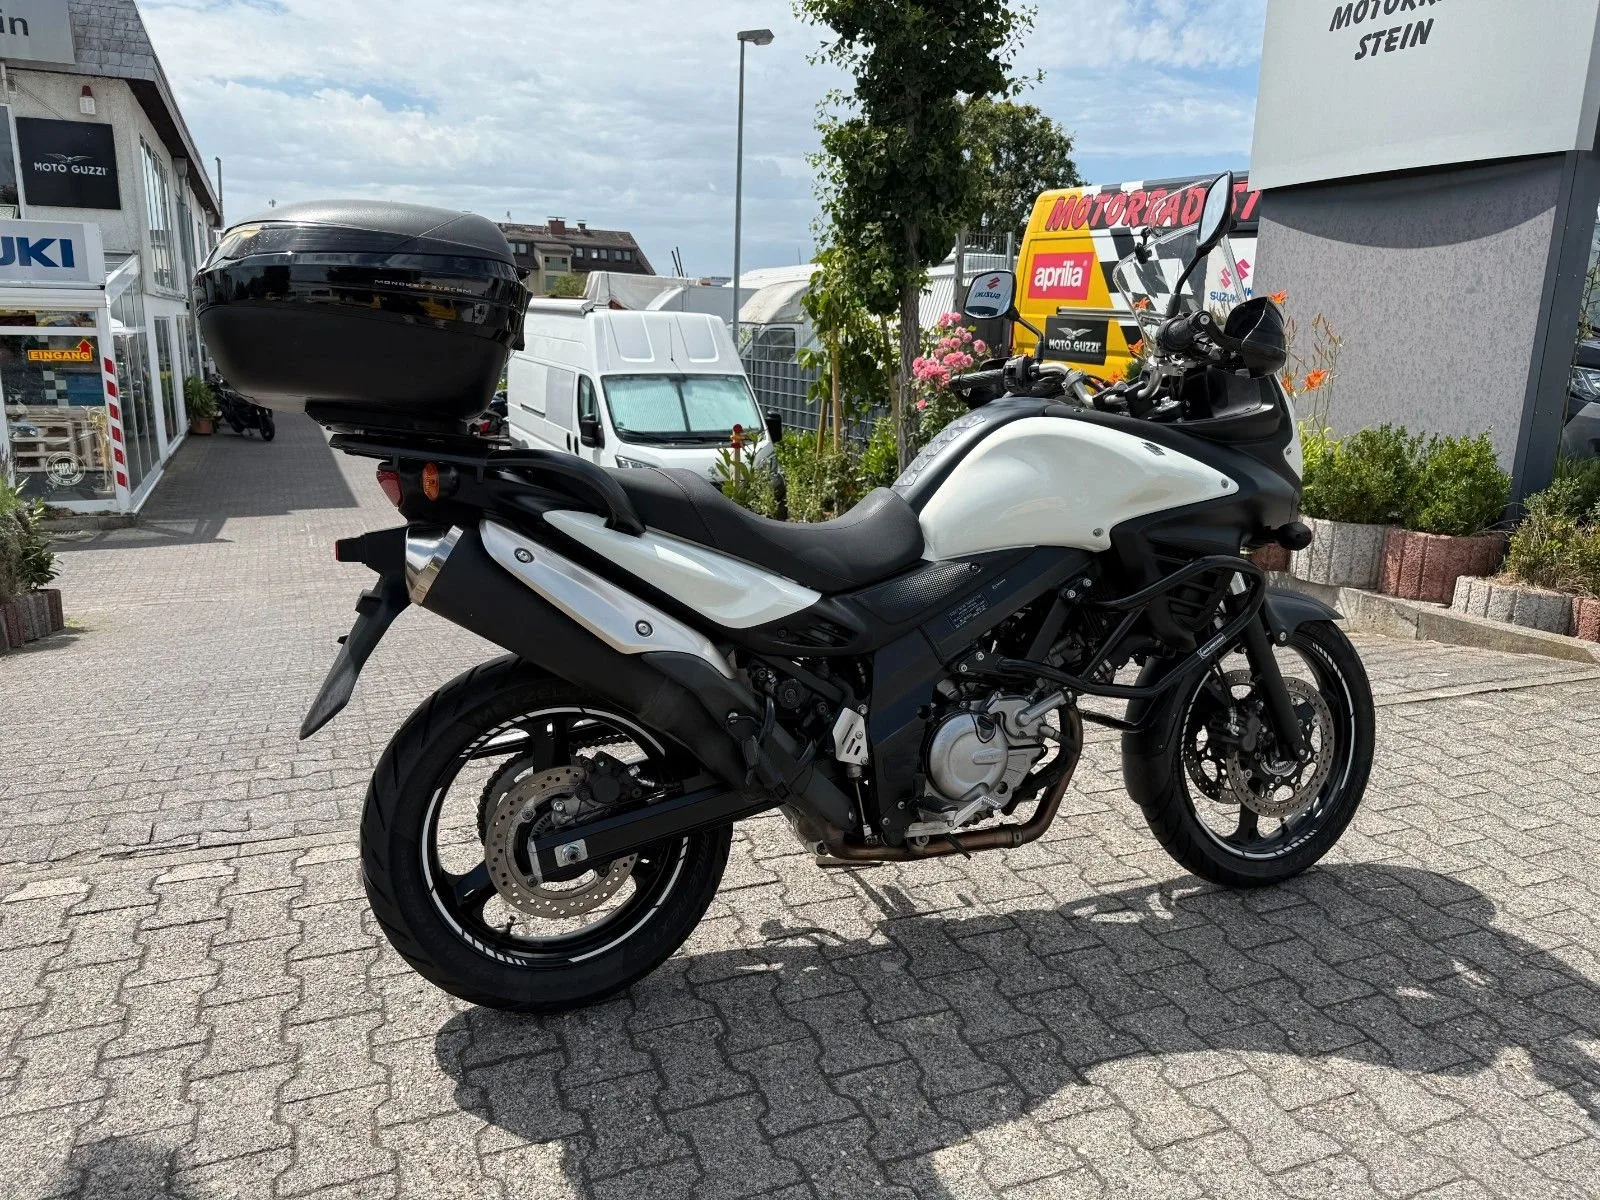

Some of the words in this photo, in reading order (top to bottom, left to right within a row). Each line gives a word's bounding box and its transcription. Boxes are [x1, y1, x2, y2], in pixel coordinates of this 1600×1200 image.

[1354, 18, 1434, 60] STEIN
[34, 161, 67, 173] MOTO
[71, 164, 106, 176] GUZZI
[1045, 187, 1206, 231] MOTORRAD
[1034, 260, 1083, 291] aprilia
[30, 351, 90, 360] EINGANG
[1048, 338, 1072, 351] MOTO
[1073, 340, 1099, 353] GUZZI
